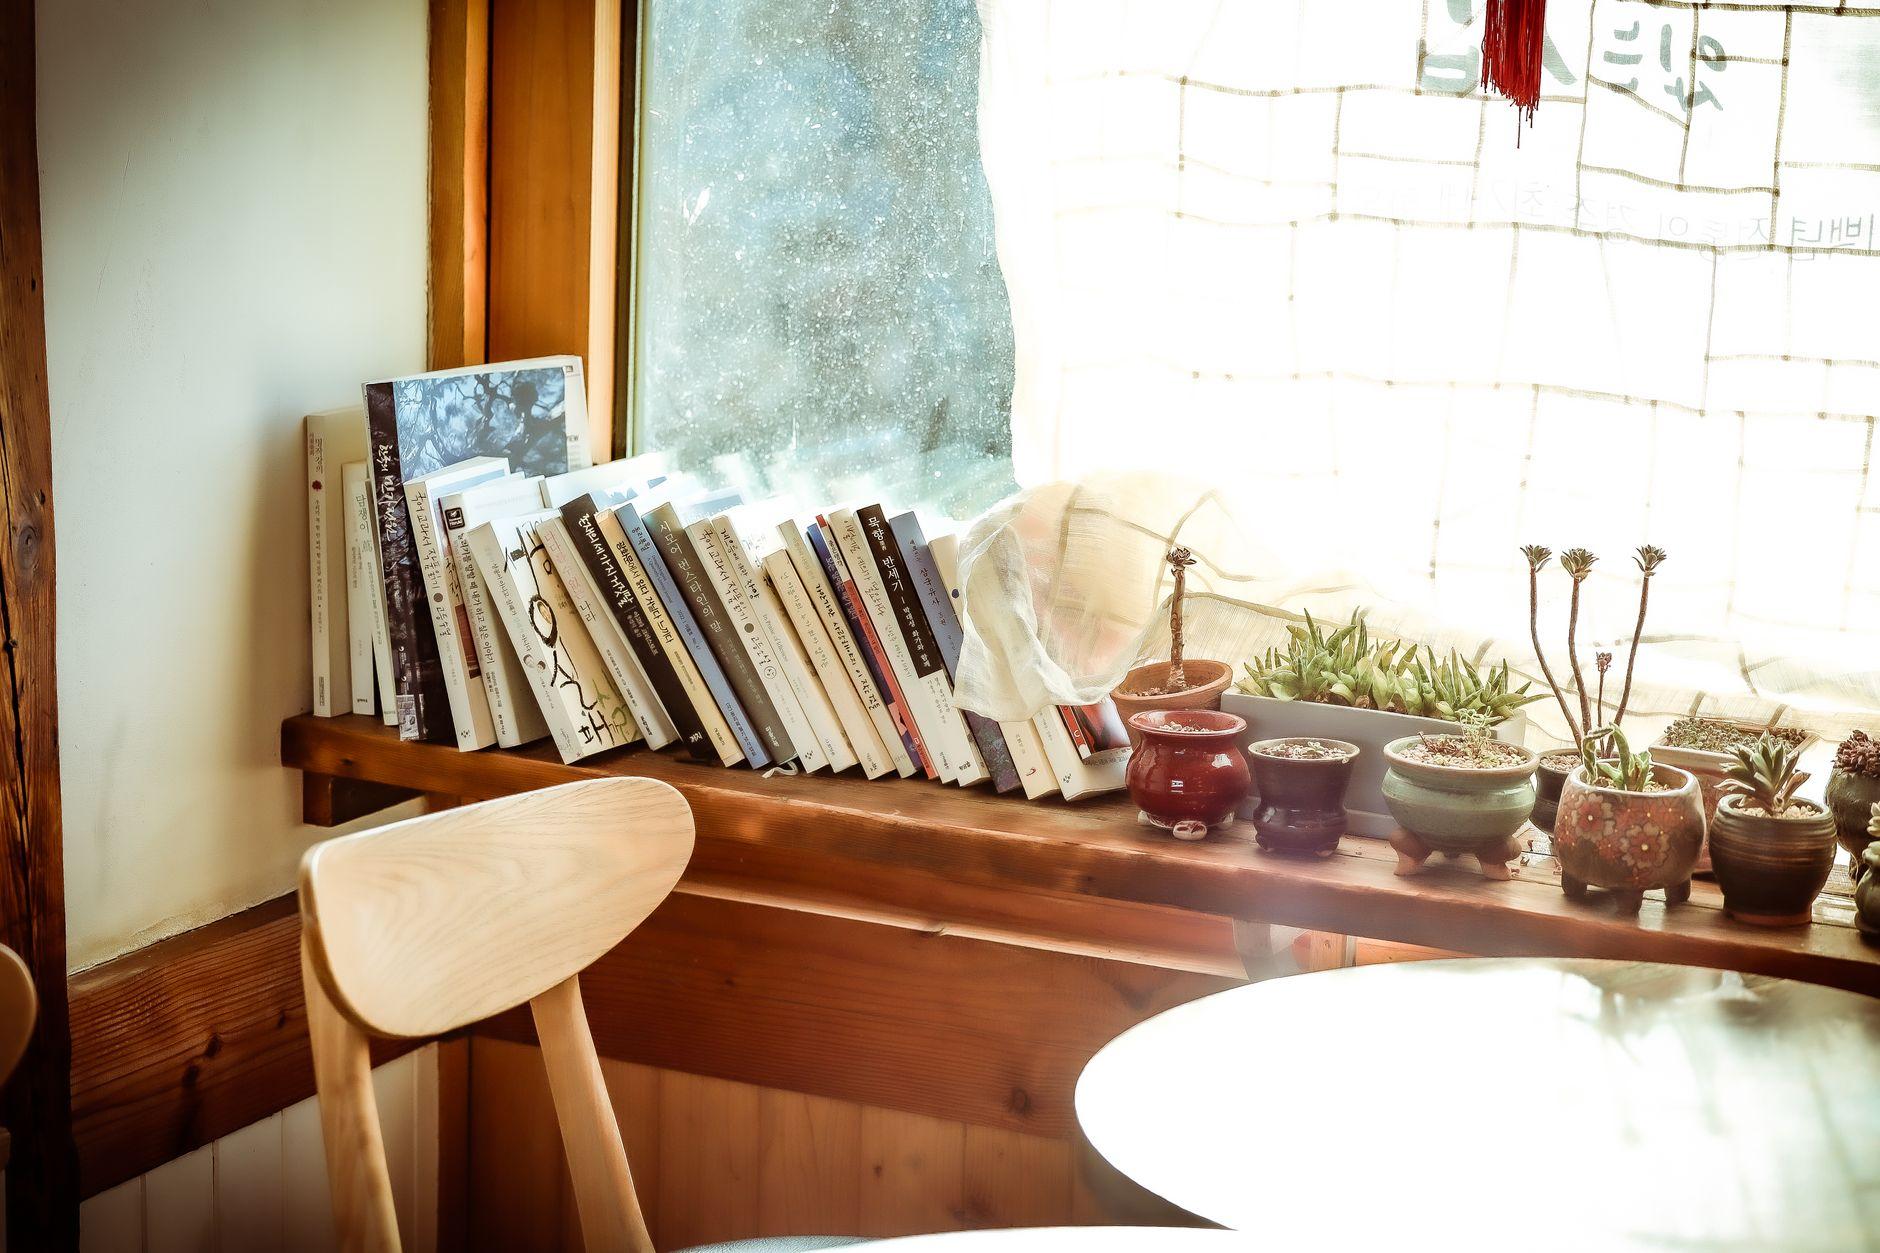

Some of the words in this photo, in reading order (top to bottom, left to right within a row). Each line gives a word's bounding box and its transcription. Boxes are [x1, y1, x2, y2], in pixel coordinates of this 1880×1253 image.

[417, 515, 431, 546] 교과서
[424, 548, 441, 589] 작품읽기
[869, 517, 884, 540] 묵향
[882, 556, 903, 591] 반세기
[709, 551, 729, 581] 교과서
[472, 591, 482, 606] 내가
[616, 541, 639, 577] 광화문에서
[636, 579, 649, 595] 읽다
[646, 596, 661, 619] 거닐다
[657, 620, 674, 643] 느끼다
[476, 608, 485, 623] 하고
[478, 625, 489, 639] 싶은
[483, 641, 495, 664] 이야기
